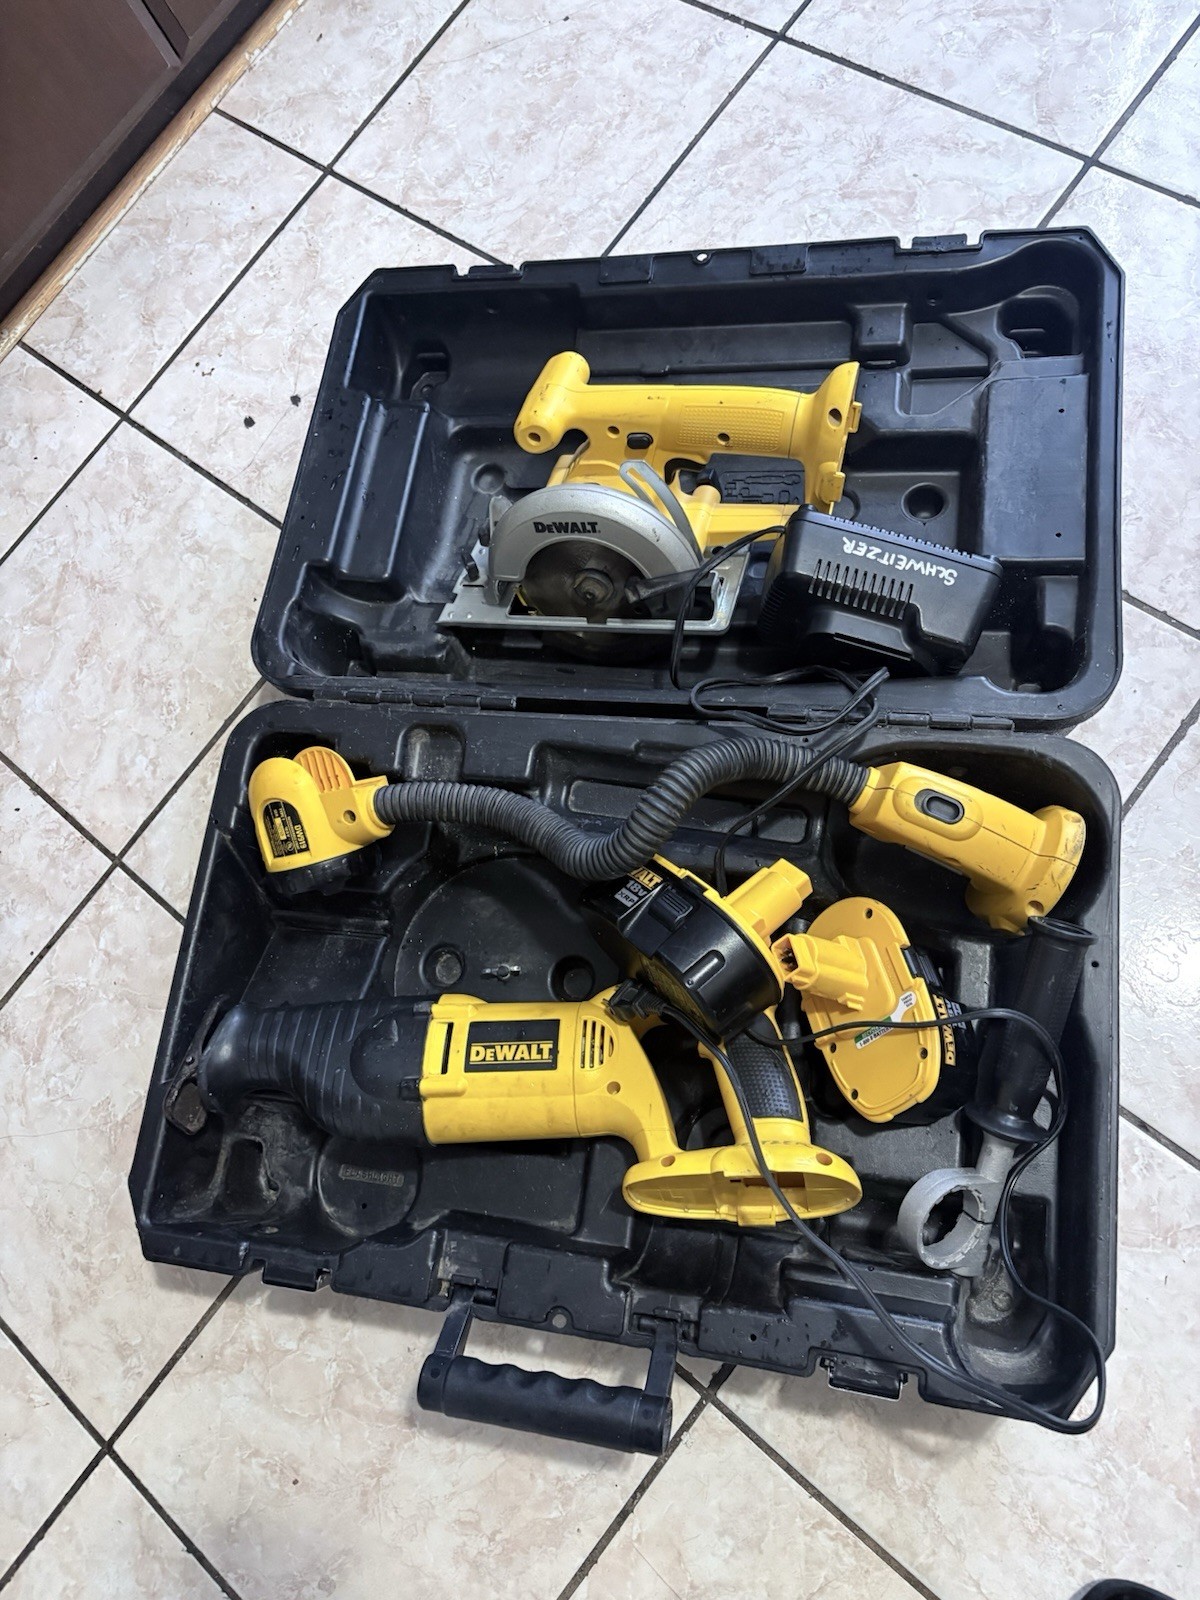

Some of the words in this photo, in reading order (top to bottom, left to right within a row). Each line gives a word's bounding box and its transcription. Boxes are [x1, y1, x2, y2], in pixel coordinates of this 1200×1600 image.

[842, 536, 958, 586] SCHWEITZER
[294, 824, 307, 849] DW919
[618, 890, 635, 904] XRP
